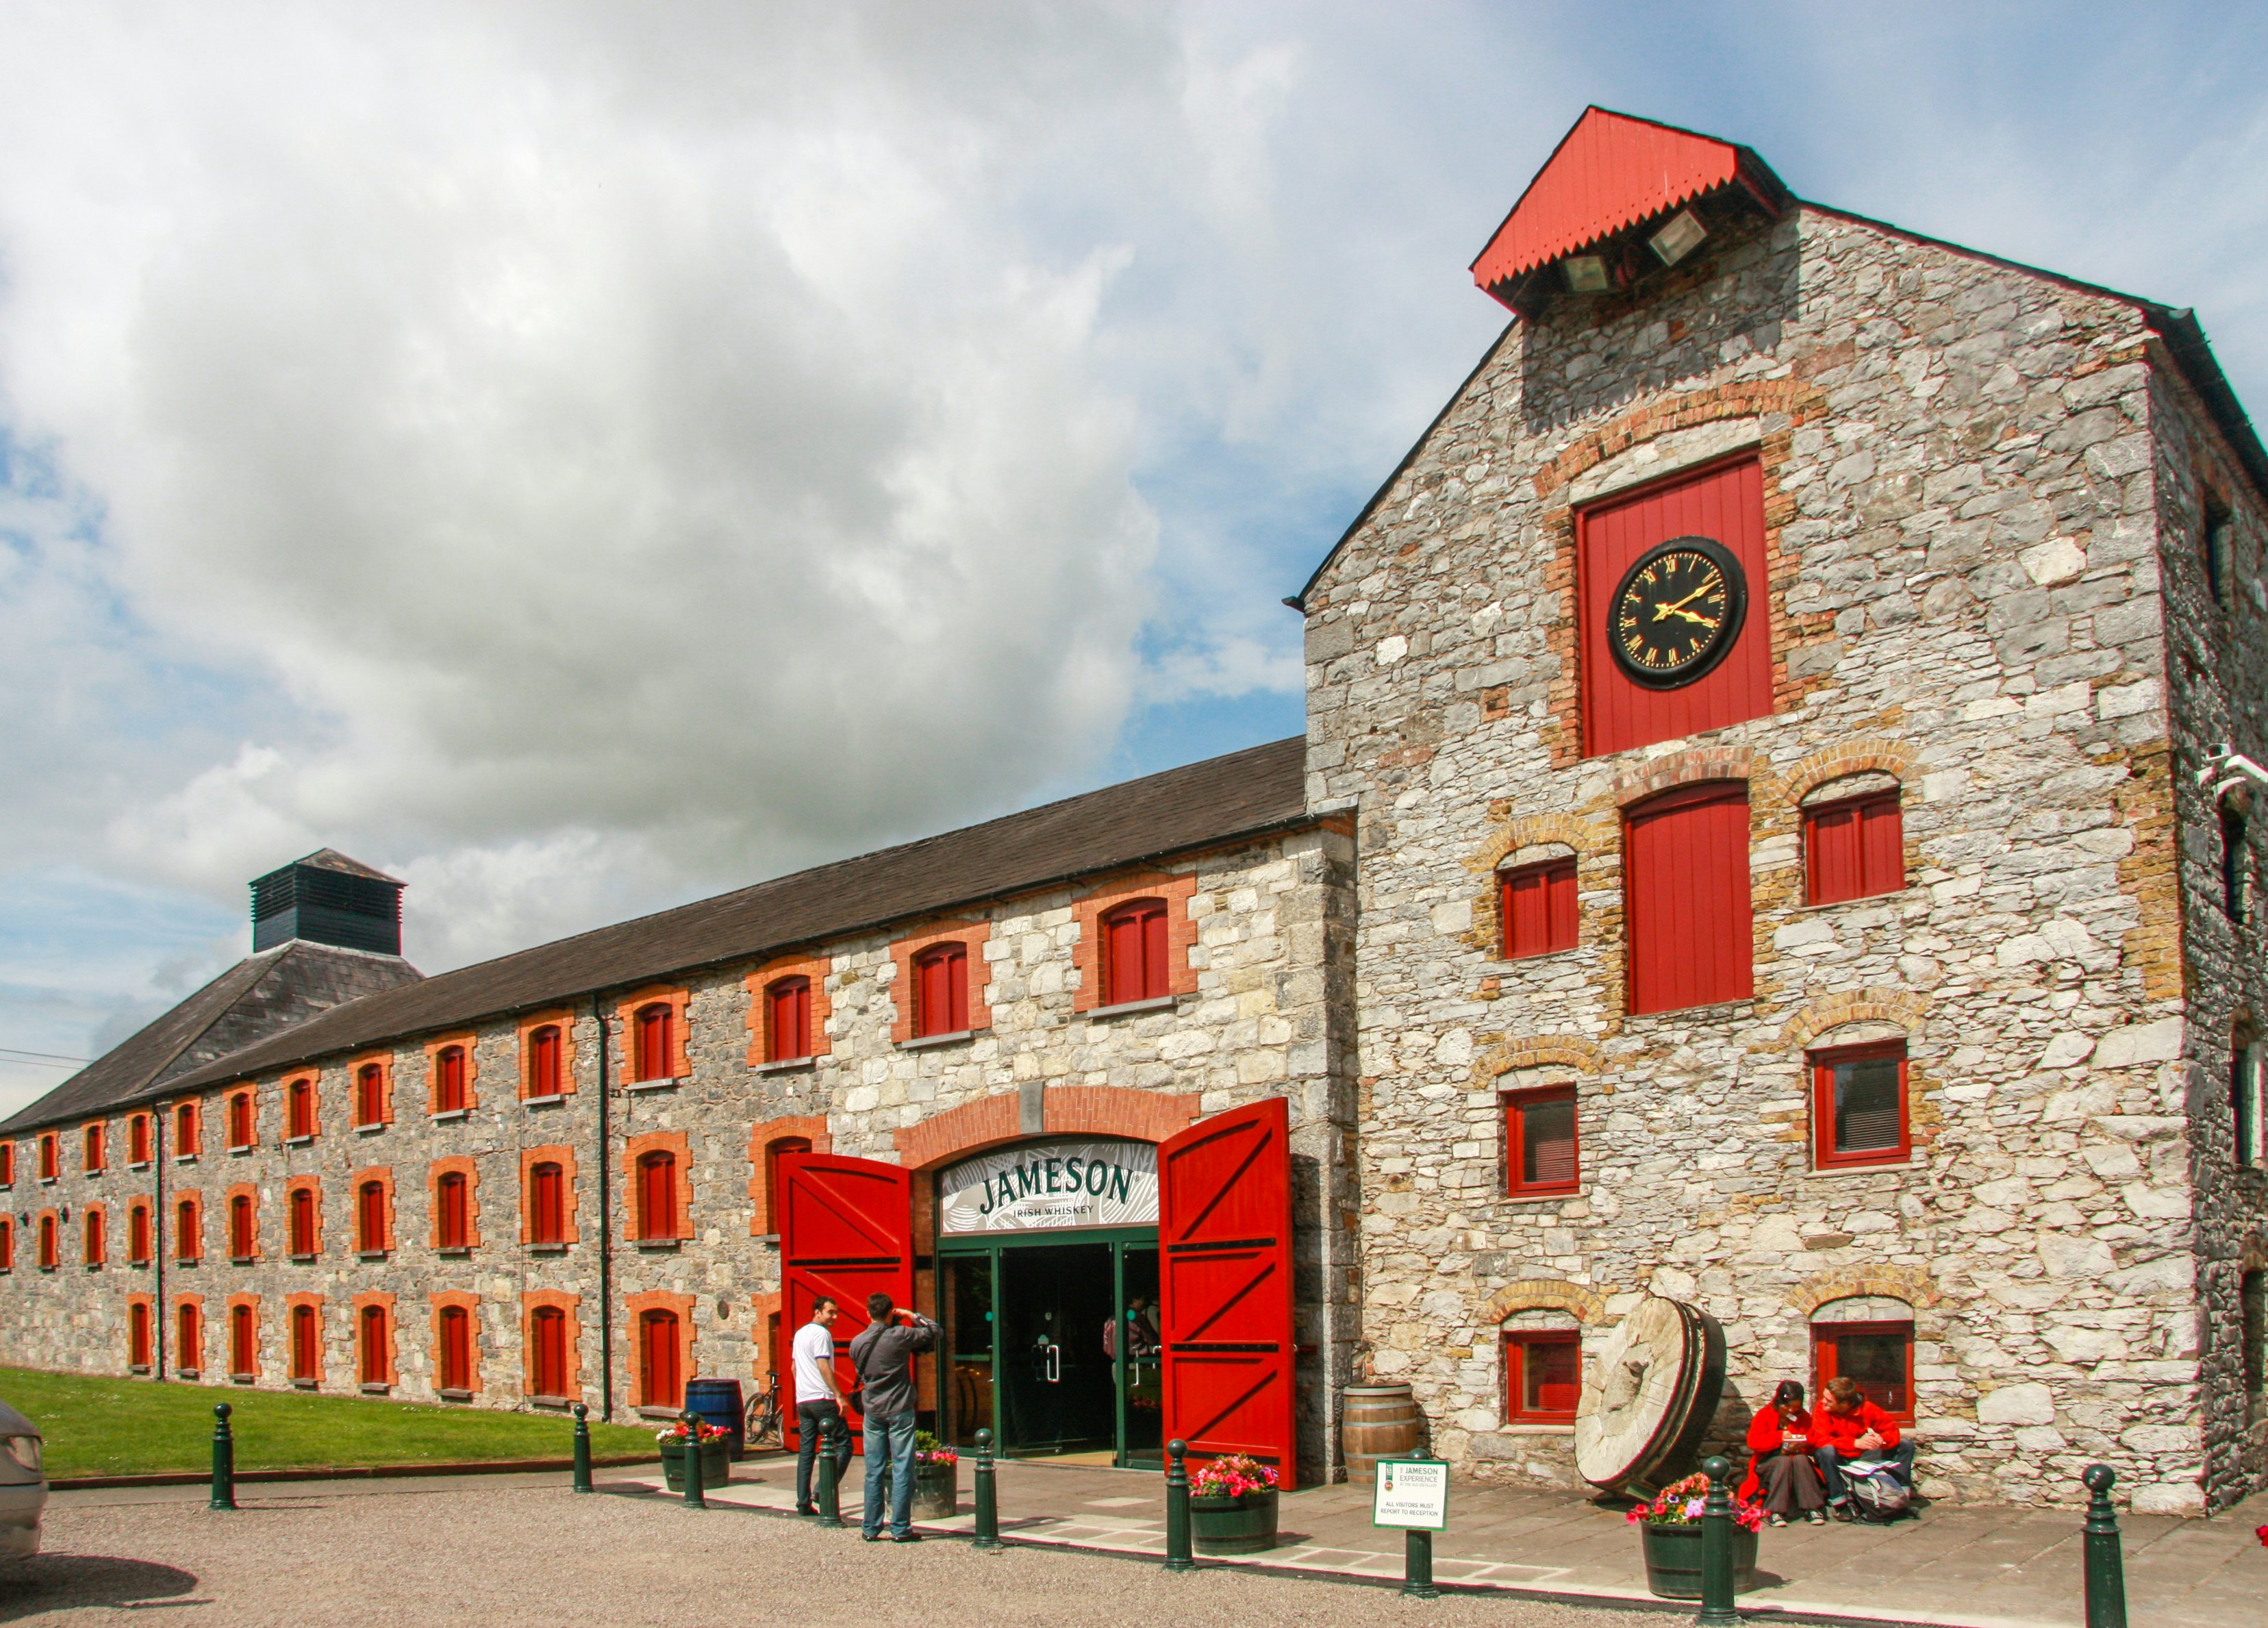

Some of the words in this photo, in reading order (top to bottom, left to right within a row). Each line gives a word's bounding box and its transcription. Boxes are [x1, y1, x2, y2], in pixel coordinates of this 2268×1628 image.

[1665, 558, 1676, 573] XII
[980, 1157, 1134, 1214] JAMESON
[1013, 1208, 1041, 1218] IRISH
[1045, 1205, 1094, 1215] WHISKEY
